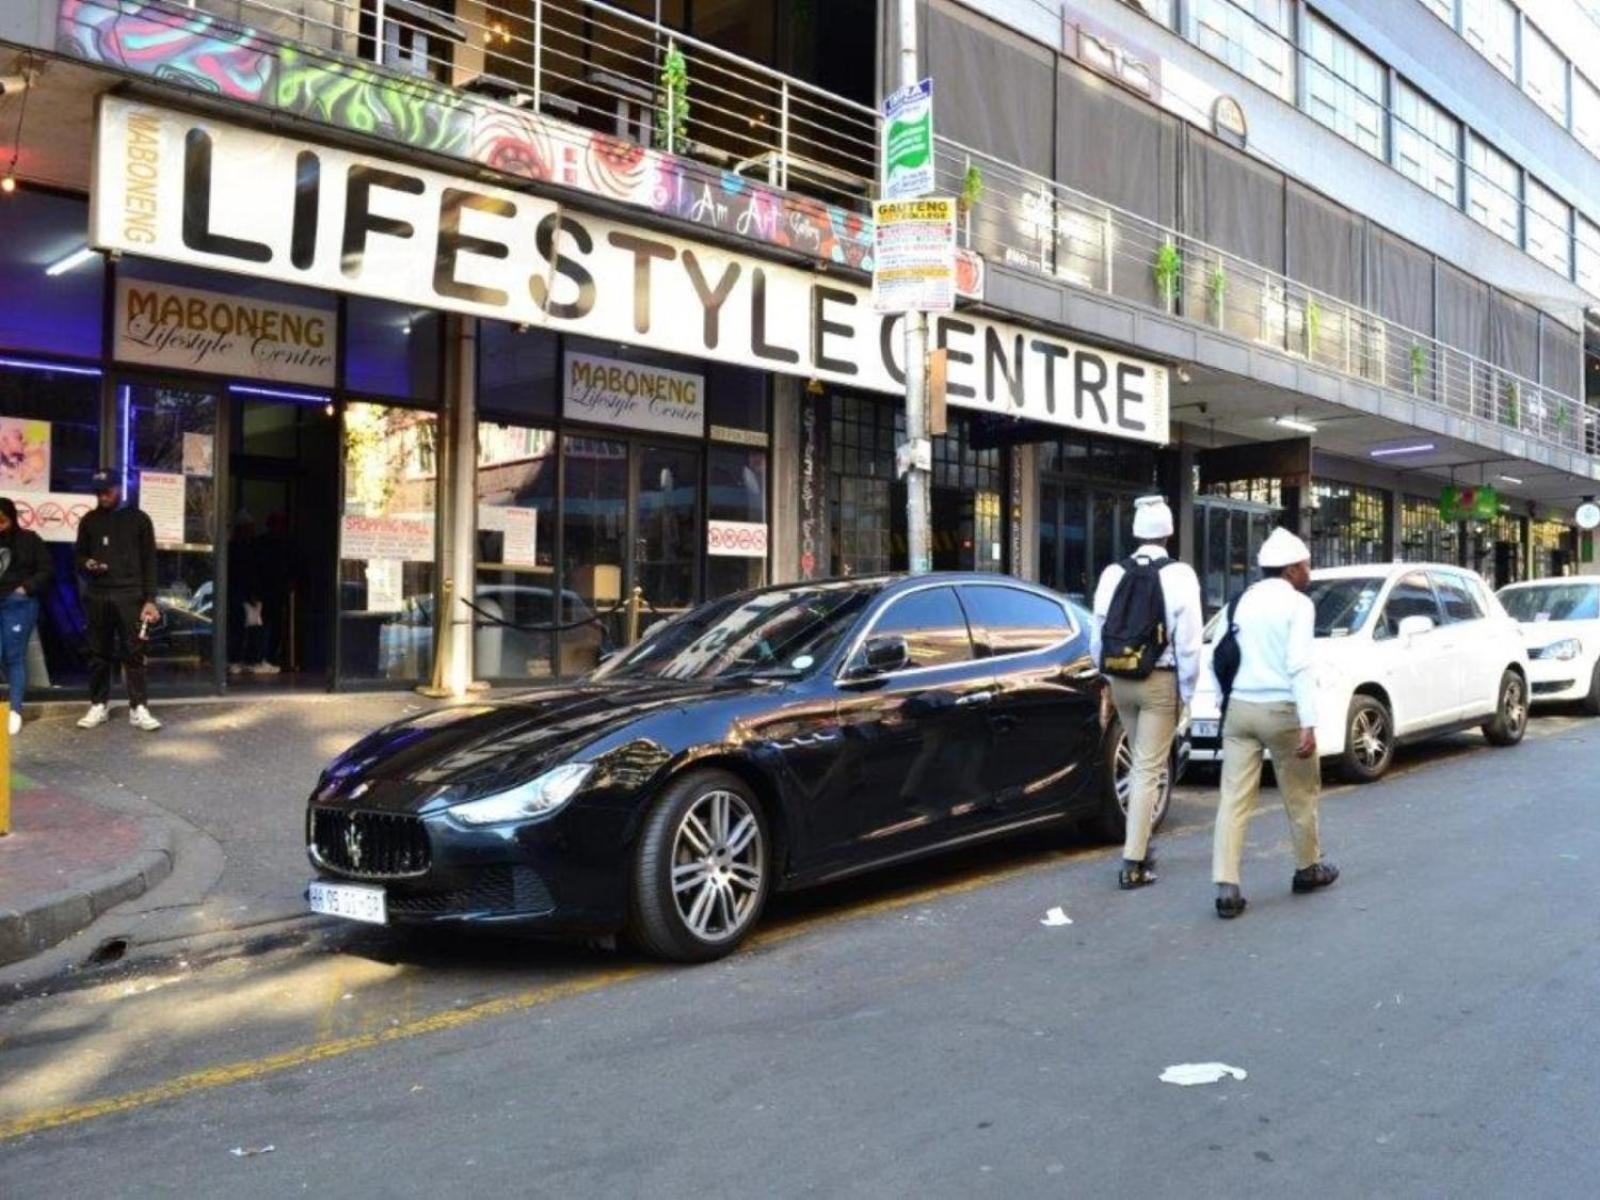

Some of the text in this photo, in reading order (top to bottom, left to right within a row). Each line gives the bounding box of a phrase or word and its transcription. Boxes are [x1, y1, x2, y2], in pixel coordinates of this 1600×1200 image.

[123, 111, 161, 245] MABONENG
[690, 184, 728, 227] Am
[736, 190, 779, 239] Art
[878, 202, 948, 215] GAUTENG
[182, 128, 859, 376] LIFESTYLE
[122, 312, 332, 368] Lifestyle Centre
[128, 288, 325, 348] MABONENG
[566, 380, 703, 421] Lifestyle Centre
[572, 359, 697, 405] MABONENG
